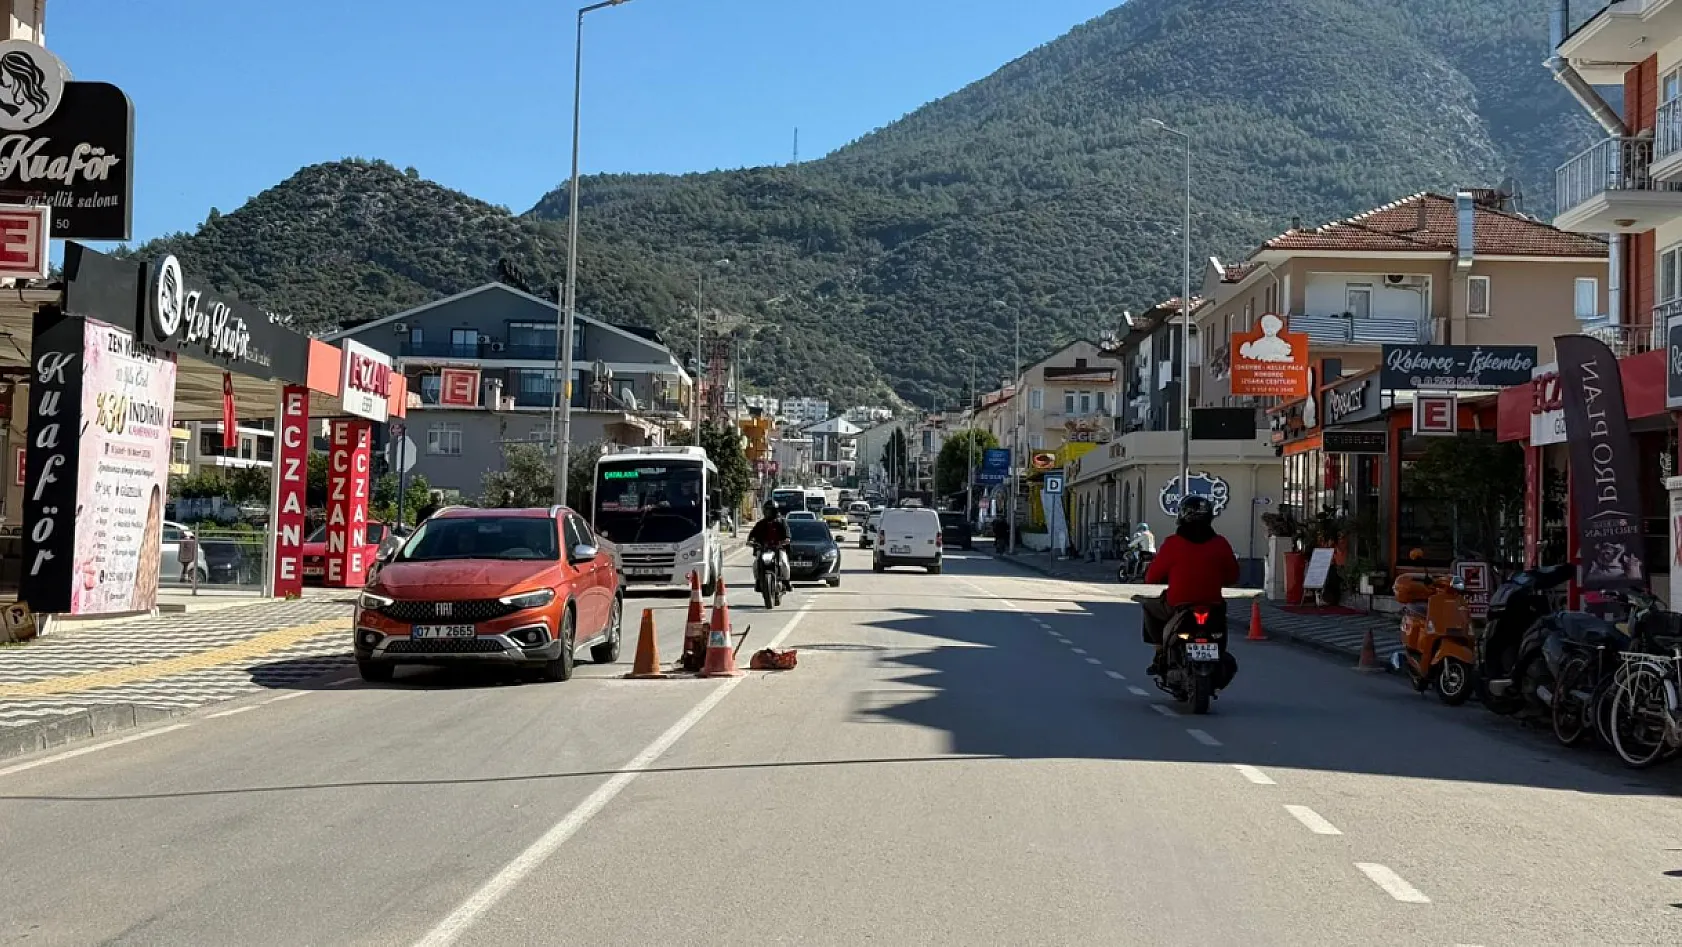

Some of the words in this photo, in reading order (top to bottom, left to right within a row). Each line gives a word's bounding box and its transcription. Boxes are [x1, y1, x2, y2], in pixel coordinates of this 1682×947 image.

[1425, 402, 1447, 427] E
[281, 393, 303, 580] ECZANE
[328, 423, 349, 582] ECZANE
[351, 428, 367, 573] ECZANE
[1050, 480, 1059, 490] D
[417, 626, 431, 637] 07
[435, 627, 442, 637] Y
[446, 626, 473, 637] 2665
